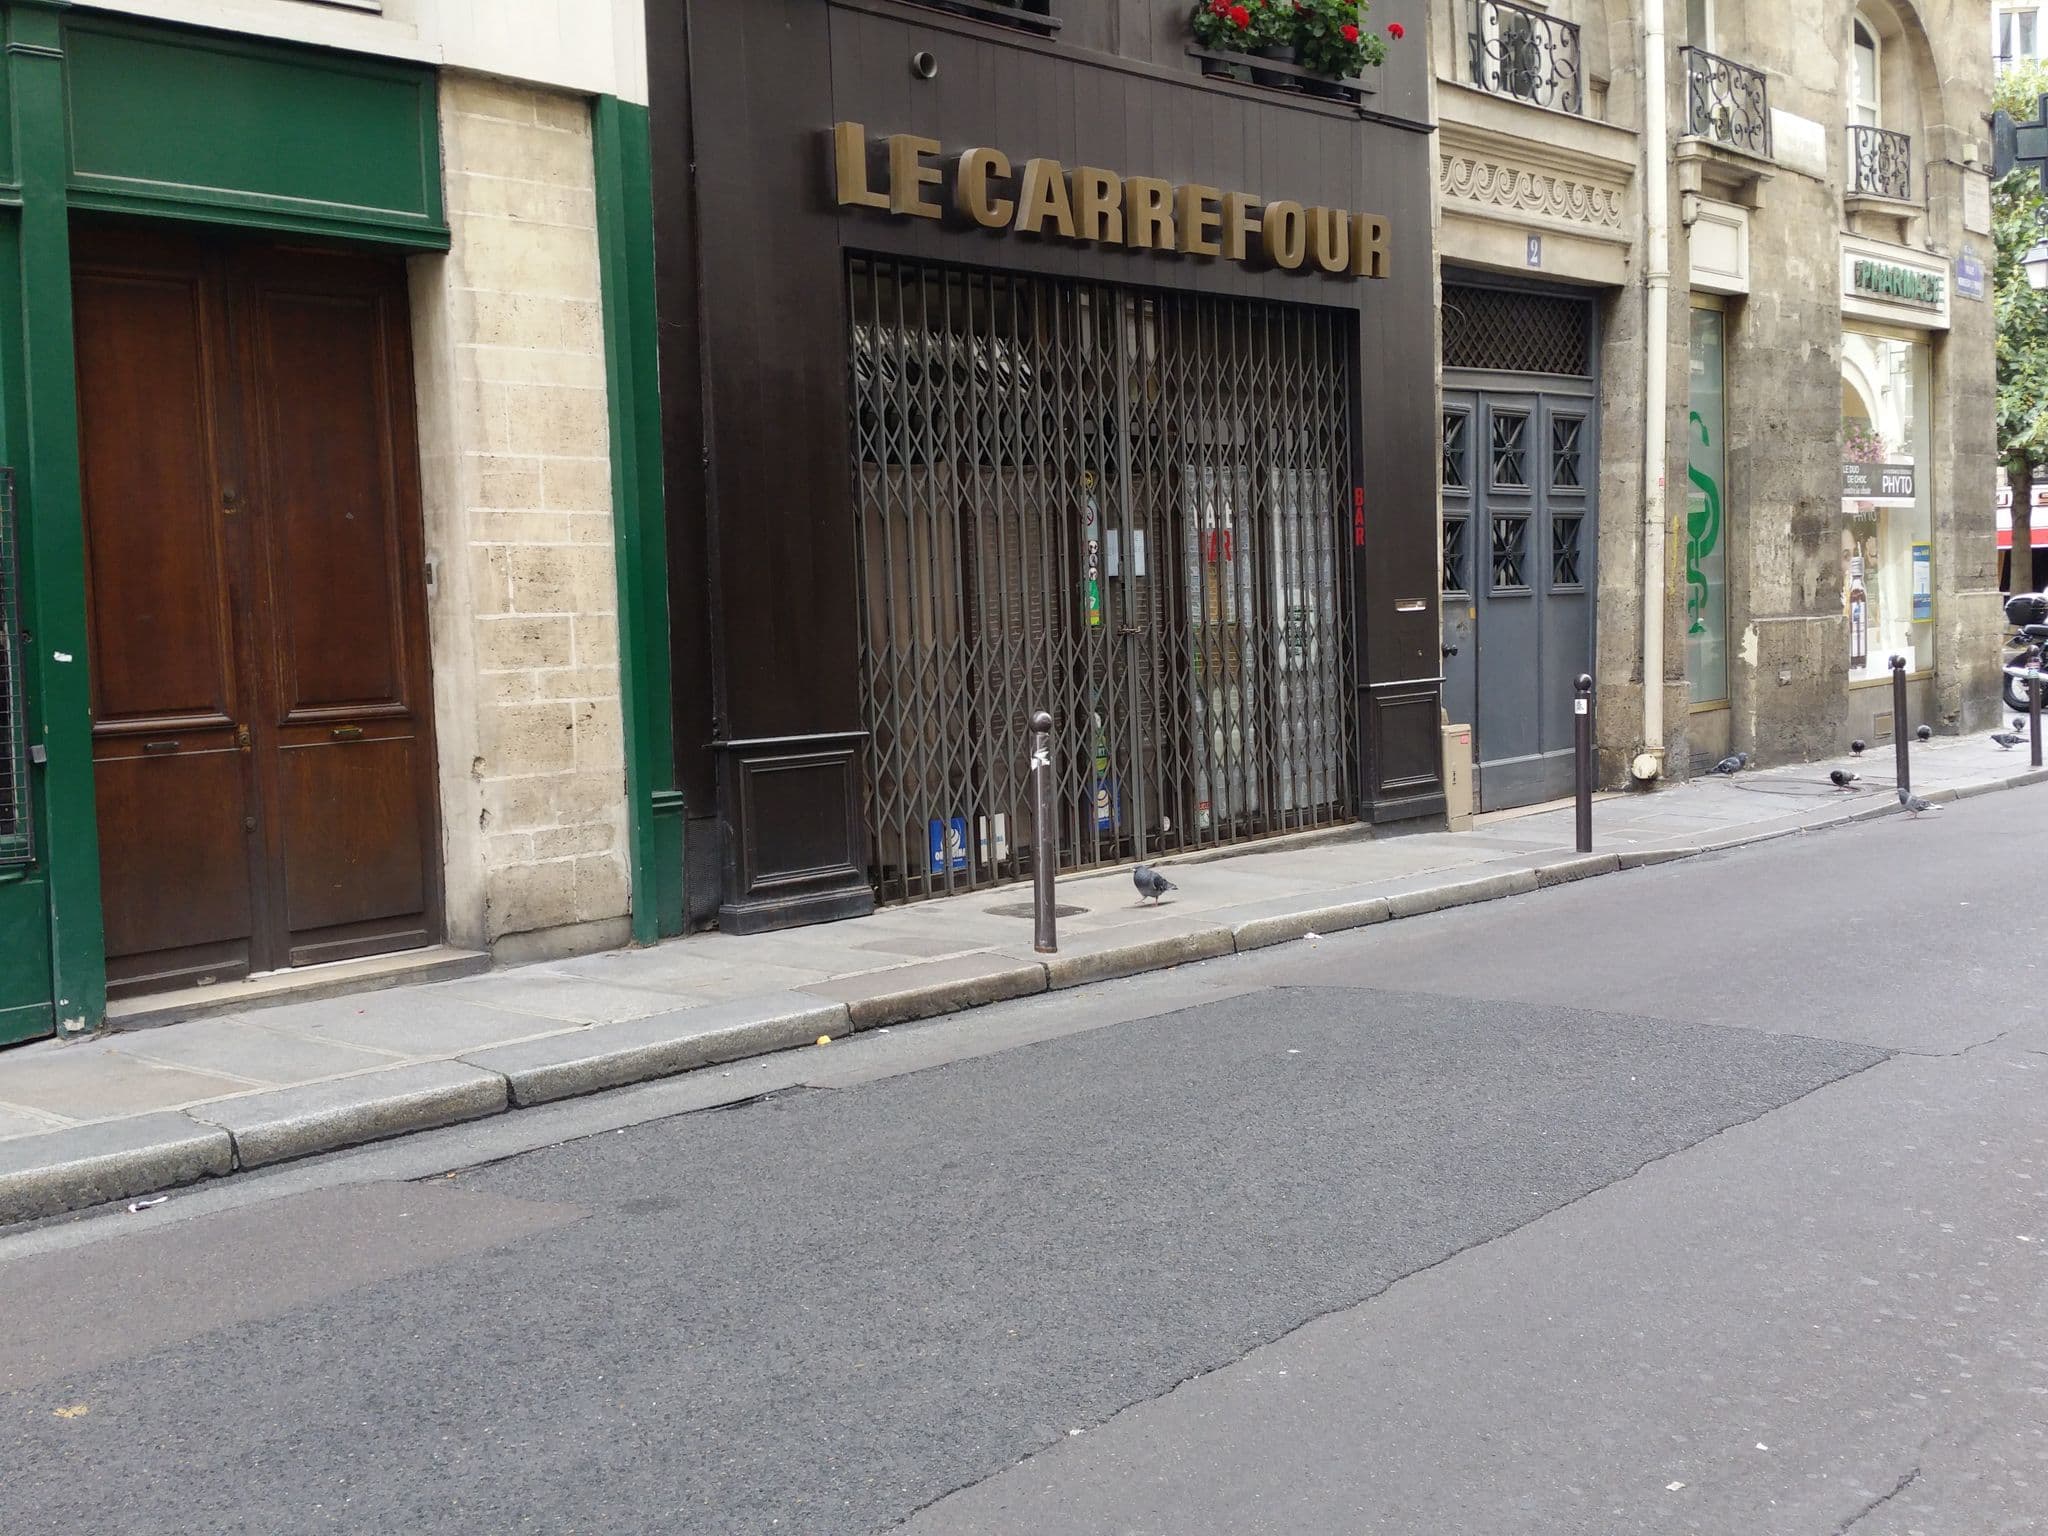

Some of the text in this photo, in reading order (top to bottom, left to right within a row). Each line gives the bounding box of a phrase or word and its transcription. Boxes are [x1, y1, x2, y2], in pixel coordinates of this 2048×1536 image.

[835, 121, 1392, 279] LE CARREFOUR
[1530, 239, 1538, 263] 2
[1855, 260, 1944, 303] PHARMACIE
[1882, 475, 1912, 494] PHYTO
[1354, 487, 1365, 546] BAR
